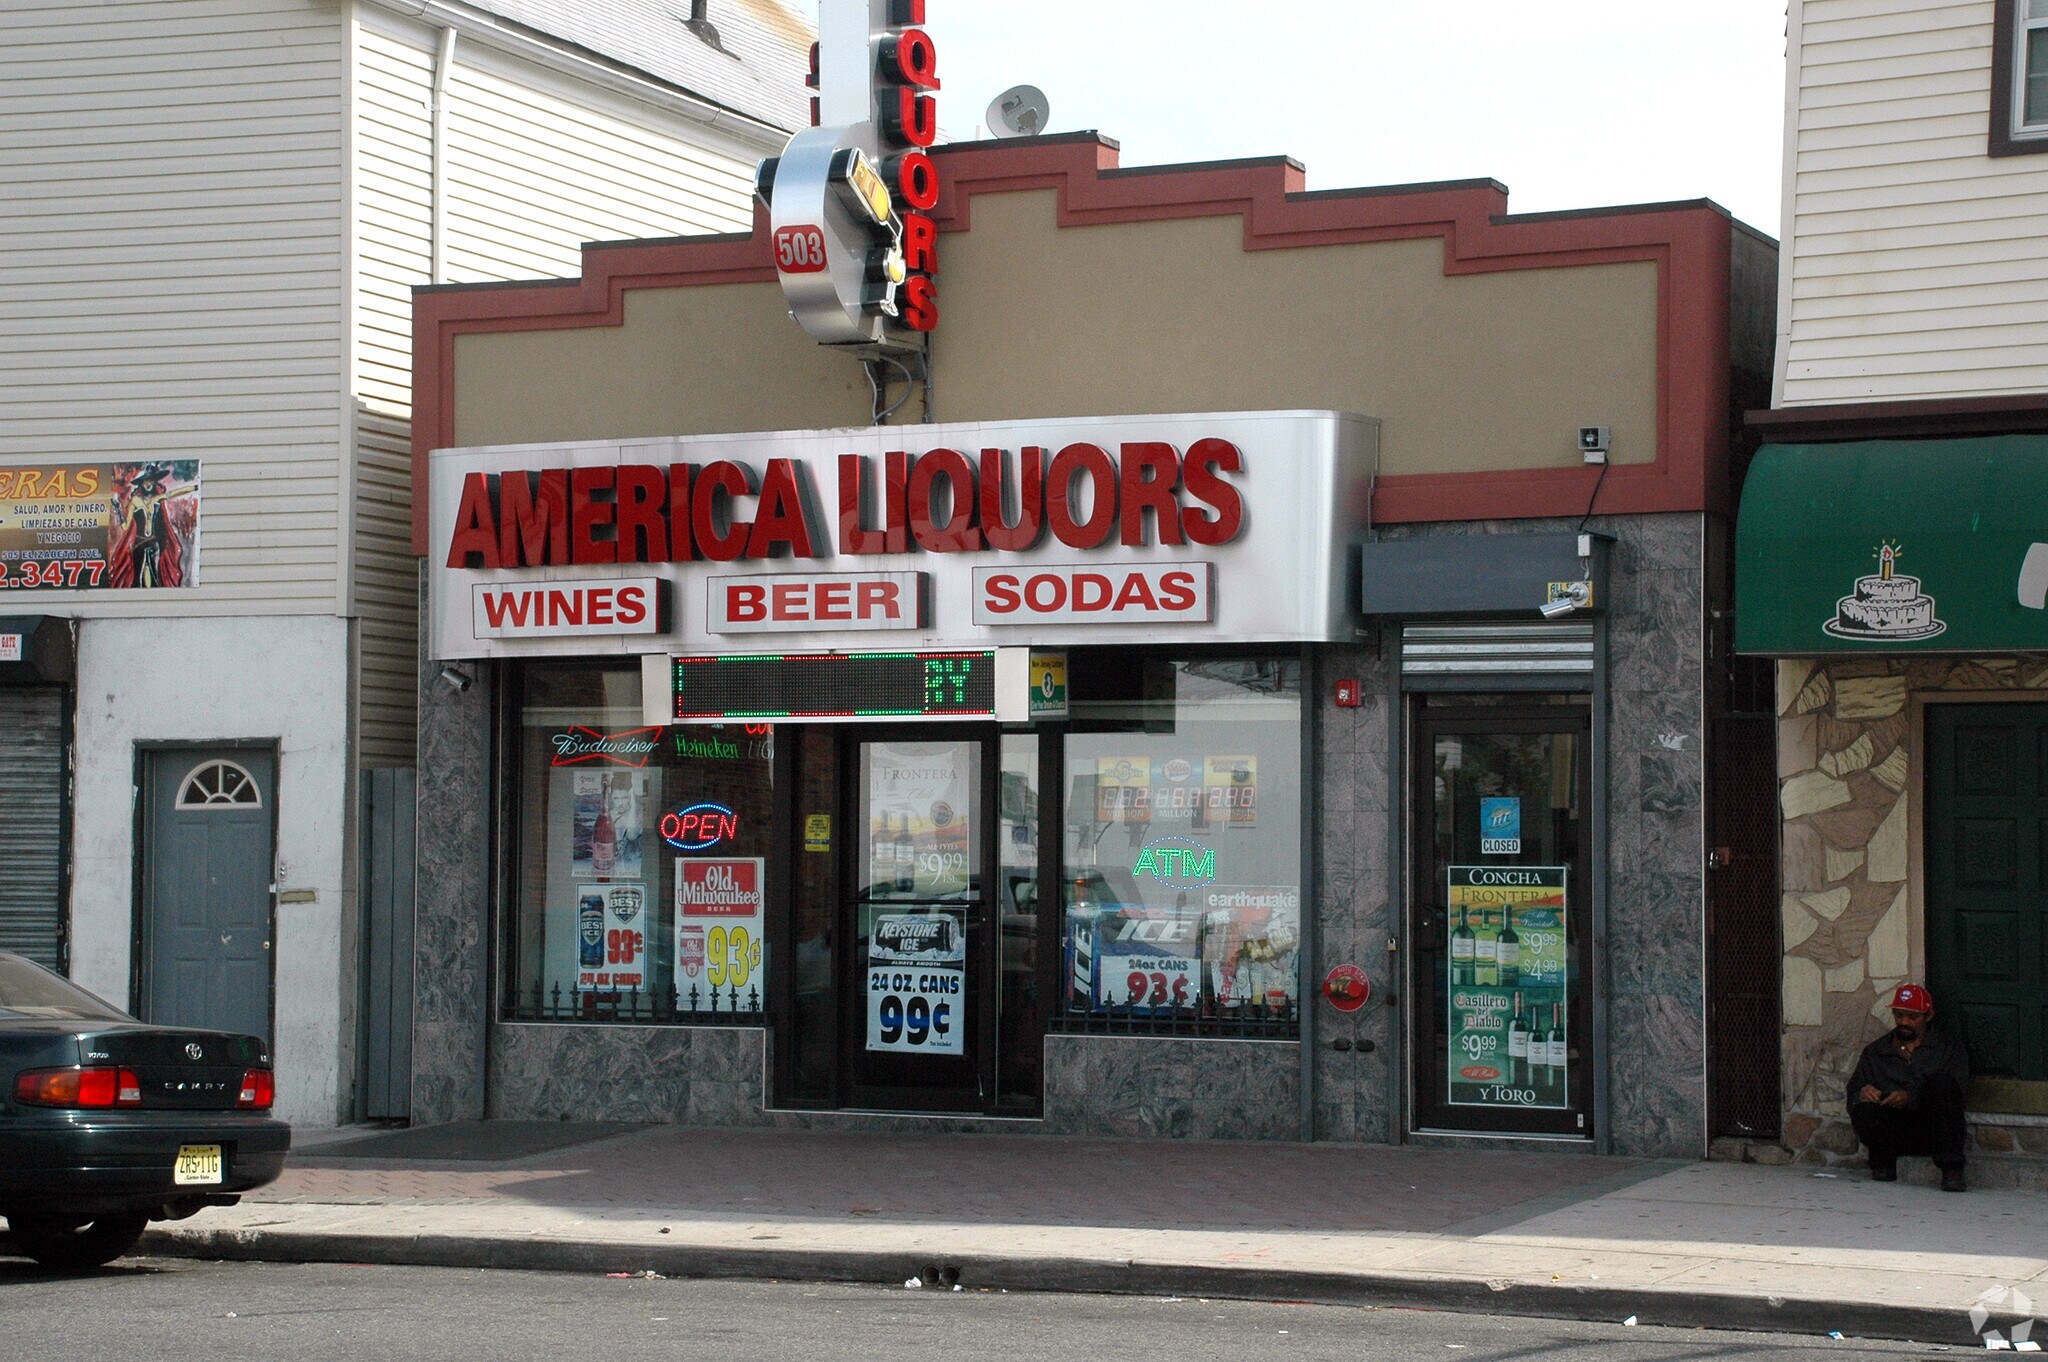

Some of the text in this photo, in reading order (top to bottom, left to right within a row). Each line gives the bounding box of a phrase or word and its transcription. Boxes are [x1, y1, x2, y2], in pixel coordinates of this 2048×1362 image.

[777, 231, 824, 266] 503
[14, 503, 107, 515] SALUD, AMOR Y DINERO.
[446, 438, 1245, 568] AMERICA LIQUORS
[21, 518, 98, 528] LIMPIEZAS DE CASA
[37, 532, 81, 543] Y NEGOCIO
[22, 549, 76, 560] ELIZABETH
[984, 571, 1197, 614] SODAS
[482, 586, 647, 629] WINES
[726, 582, 901, 623] BEER
[552, 734, 660, 756] Budweiser
[676, 734, 739, 759] Heineken
[883, 767, 957, 780] FRONTERA
[1158, 809, 1197, 818] MILLION
[660, 813, 738, 840] OPEN
[1483, 840, 1519, 852] CLOSED
[1133, 847, 1216, 878] ATM
[705, 865, 734, 892] Old
[1469, 868, 1542, 885] CONCHA
[678, 881, 760, 905] Milwaukee
[1208, 891, 1297, 910] earthquake
[1460, 887, 1550, 903] FRONTERA
[610, 897, 641, 908] BEST
[880, 922, 940, 939] KEYSTONE
[1115, 919, 1193, 942] ICE
[900, 938, 919, 951] ICE
[707, 925, 761, 988] 93¢
[1158, 959, 1189, 971] CANS
[872, 973, 960, 994] 24 OZ. CANS
[1455, 993, 1508, 1008] Casillero
[880, 995, 951, 1046] 99¢
[1465, 1015, 1501, 1028] Diablo
[165, 1081, 225, 1091] CAMRY
